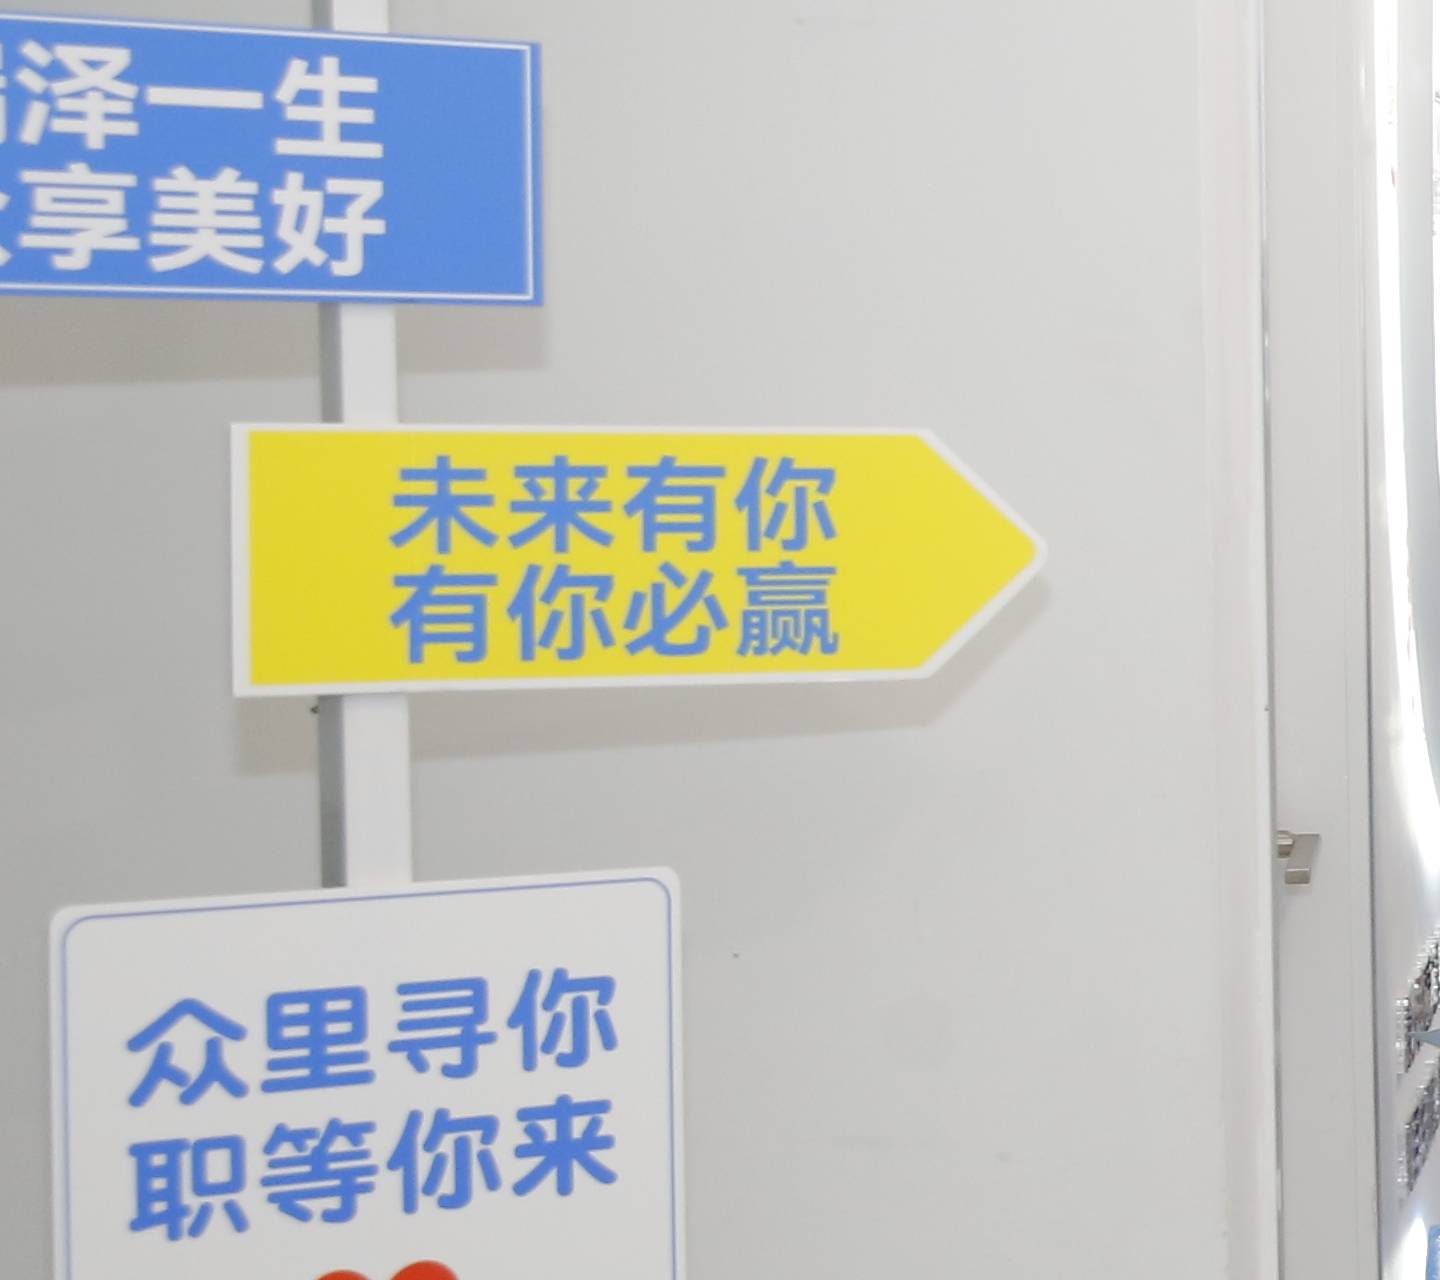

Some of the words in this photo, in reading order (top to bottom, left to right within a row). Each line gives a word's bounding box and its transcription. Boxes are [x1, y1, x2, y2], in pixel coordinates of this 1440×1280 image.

[0, 38, 385, 160] 泽一生
[0, 162, 387, 279] 享美好
[388, 454, 839, 555] 未来有你
[388, 560, 840, 665] 有你必赢
[125, 966, 620, 1110] 众里寻你
[127, 1093, 619, 1243] 职等你来
